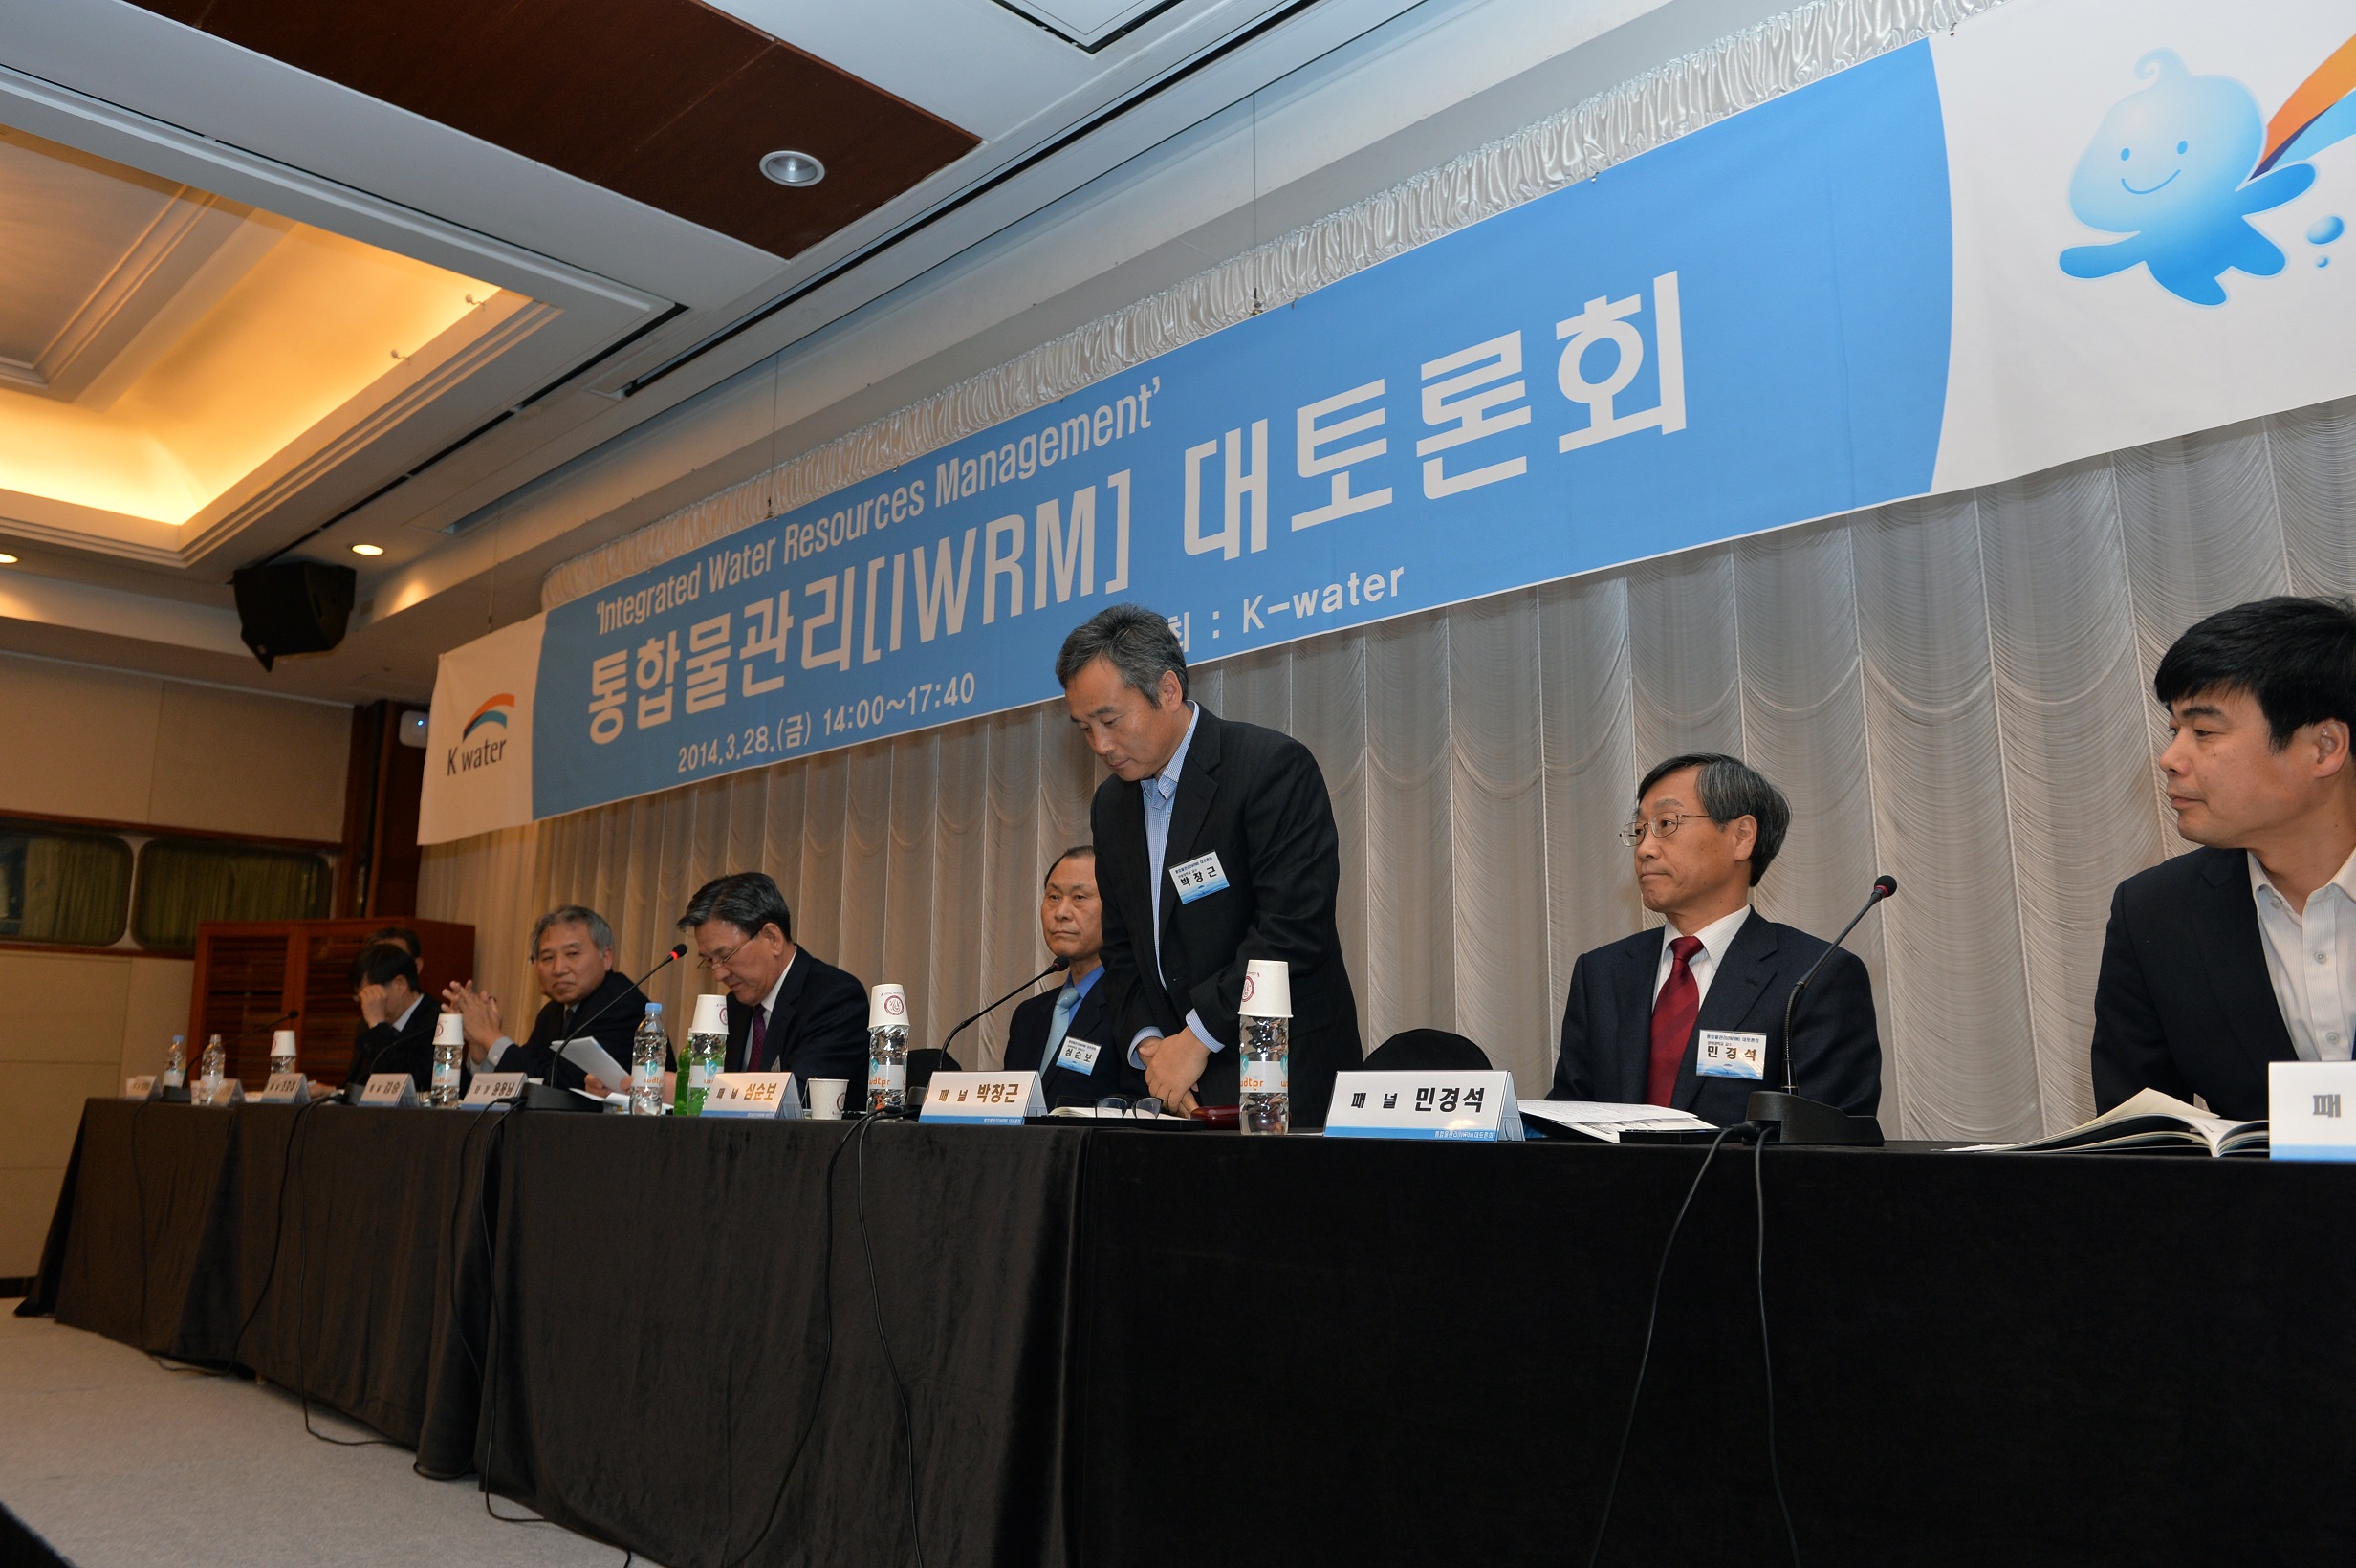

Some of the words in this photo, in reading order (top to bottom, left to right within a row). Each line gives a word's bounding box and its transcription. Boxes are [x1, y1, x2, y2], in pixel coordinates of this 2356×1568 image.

[1184, 270, 1687, 562] 대토론회
[709, 537, 776, 593] Water
[783, 480, 925, 565] Resources
[1243, 566, 1404, 634] K-water
[677, 711, 812, 773] 2014.3.28.(금)
[823, 672, 975, 736] 14:00~17:40
[447, 746, 458, 777] K
[462, 738, 507, 772] water
[744, 1083, 777, 1100] 심순보
[976, 1083, 1019, 1103] 박창근
[1415, 1087, 1485, 1113] 민경석
[2312, 1094, 2342, 1119] 패
